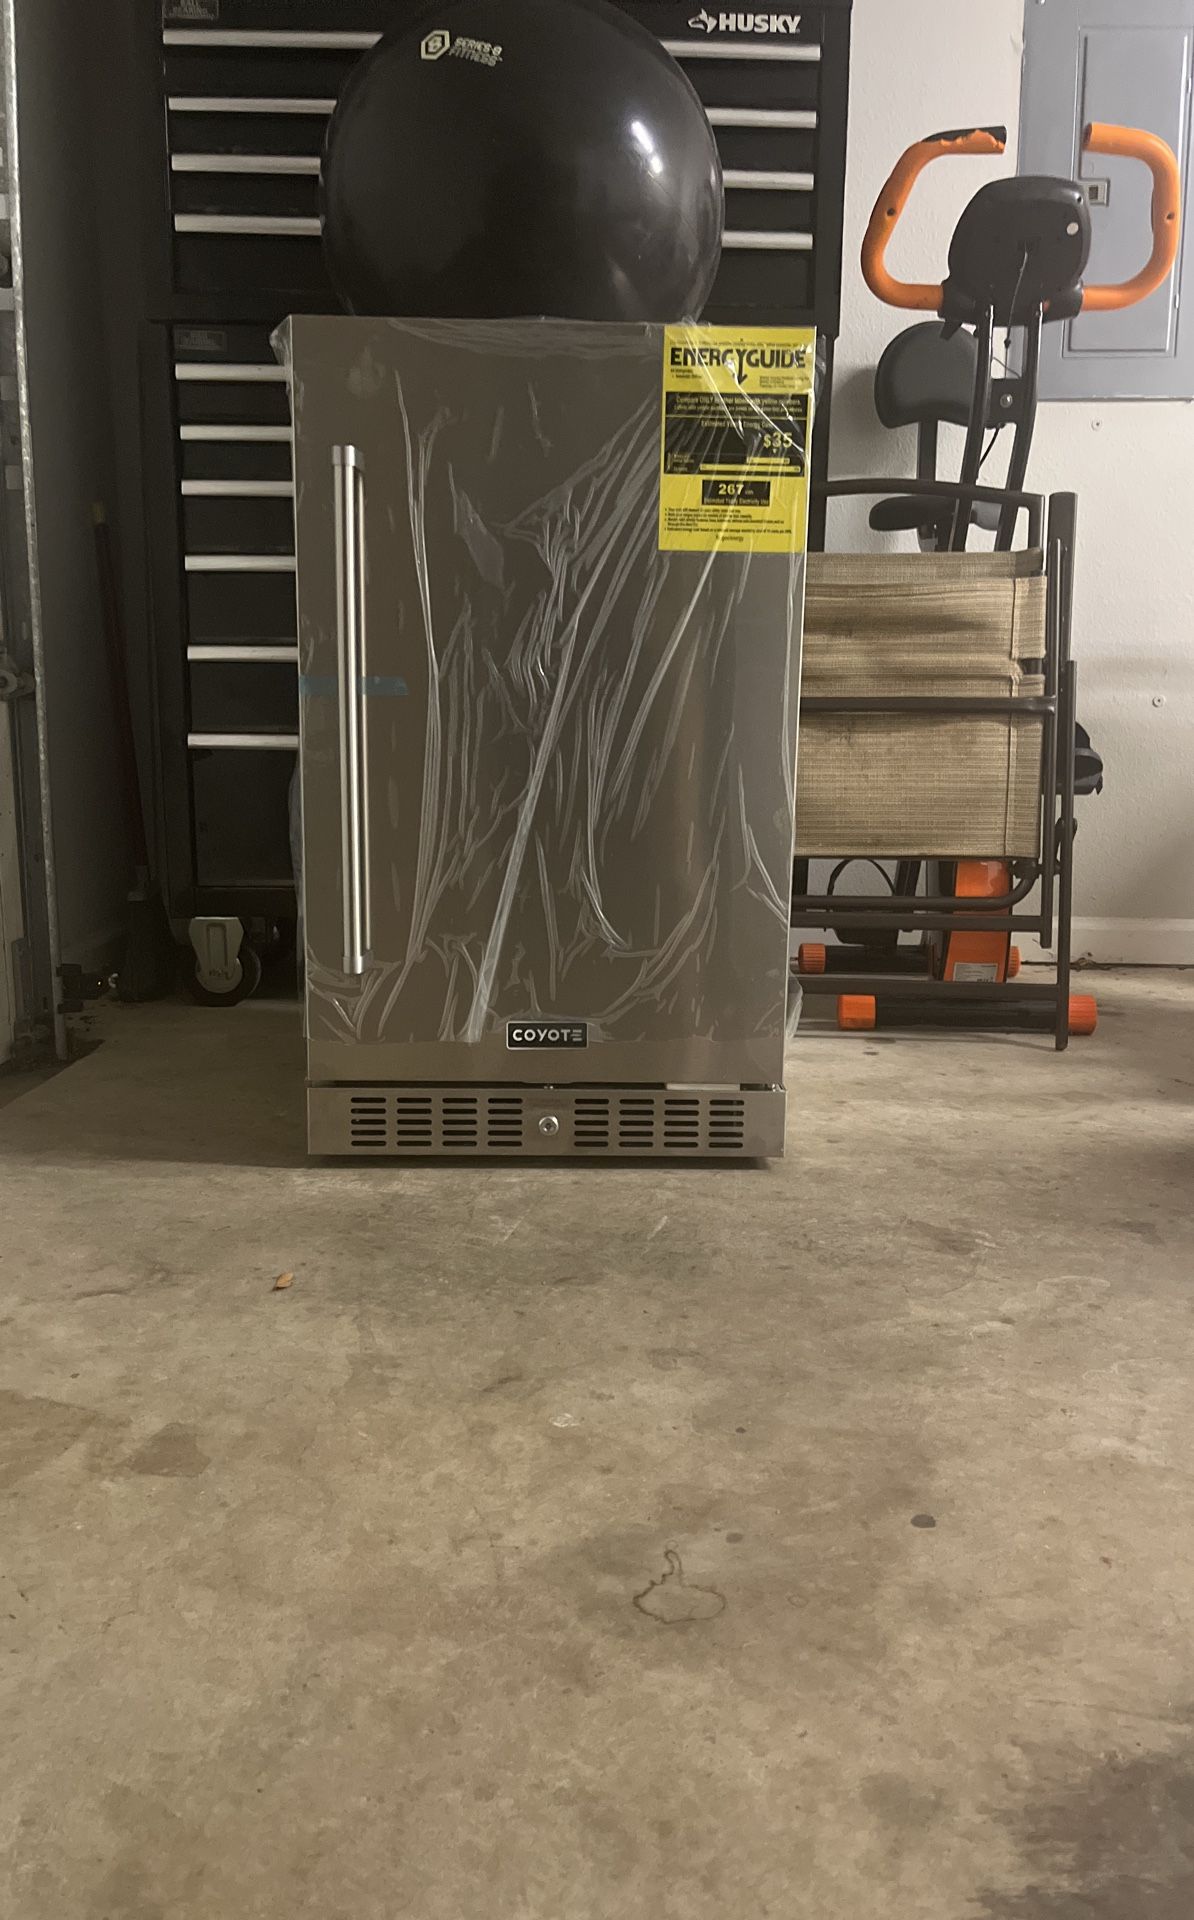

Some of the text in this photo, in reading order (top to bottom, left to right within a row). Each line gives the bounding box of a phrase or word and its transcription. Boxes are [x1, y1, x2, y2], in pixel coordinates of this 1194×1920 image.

[719, 13, 801, 33] HUSKY
[670, 347, 806, 370] ENERGYGUIDE
[763, 431, 793, 449] $35
[718, 483, 744, 496] 267
[512, 1028, 582, 1042] COYOTE
